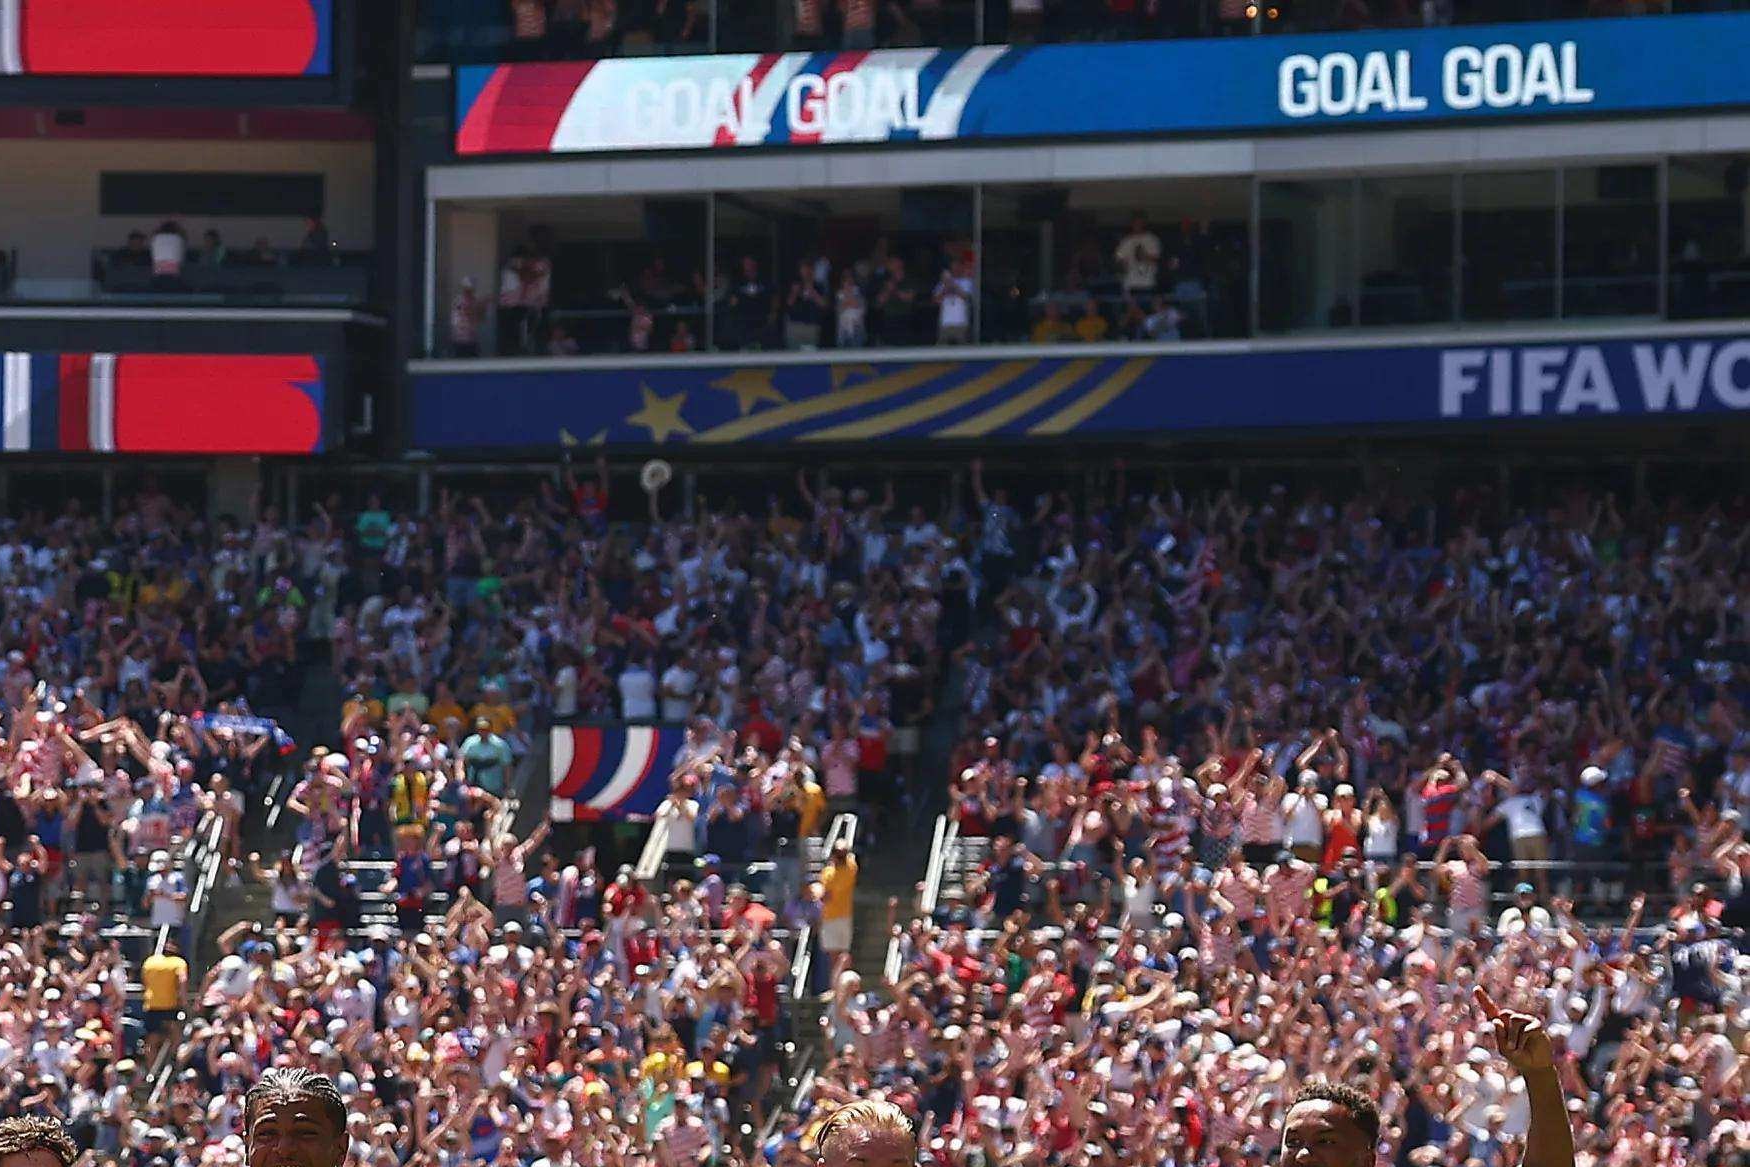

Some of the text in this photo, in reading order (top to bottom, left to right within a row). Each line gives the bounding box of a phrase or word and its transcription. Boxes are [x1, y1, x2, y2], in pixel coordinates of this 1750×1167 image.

[631, 66, 928, 137] GOAL GOAL
[1278, 40, 1596, 118] GOAL GOAL
[1440, 346, 1620, 416] FIFA
